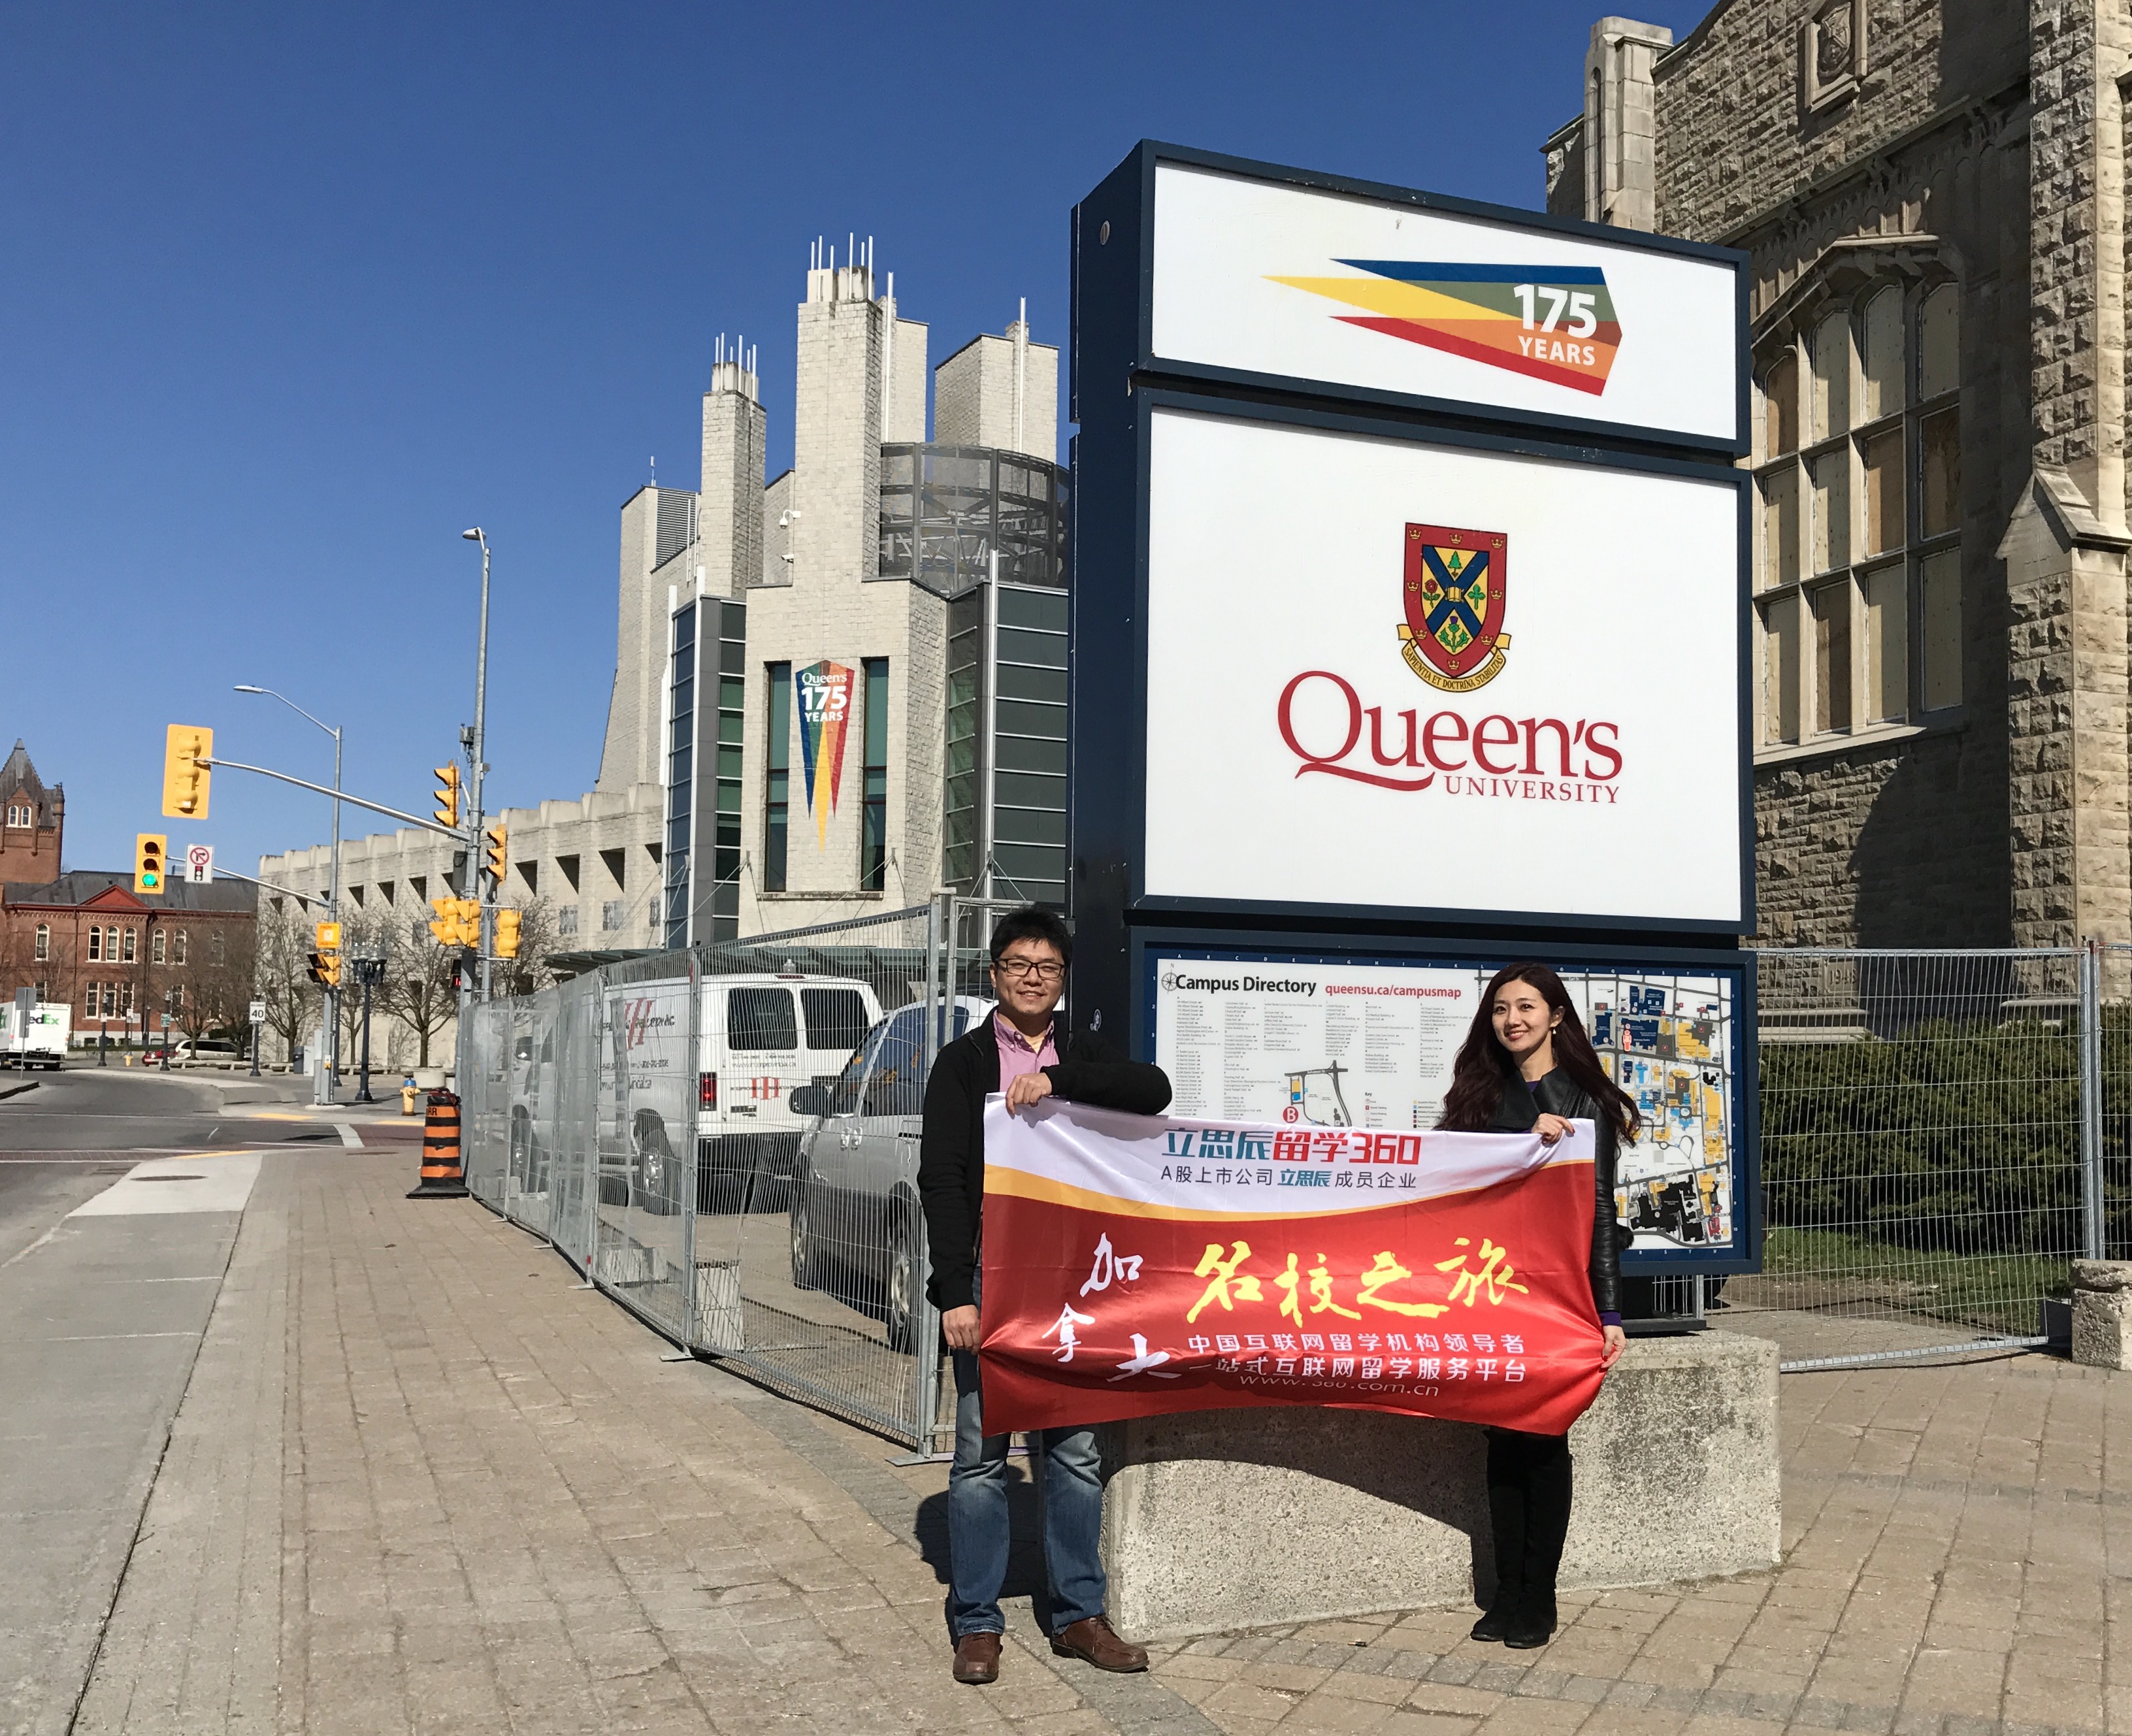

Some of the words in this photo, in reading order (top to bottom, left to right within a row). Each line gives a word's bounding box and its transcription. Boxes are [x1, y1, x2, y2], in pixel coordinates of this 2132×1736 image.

[1514, 284, 1597, 338] 175
[1518, 335, 1595, 366] YEARS
[802, 672, 847, 686] Queen's
[1404, 647, 1432, 681] SAPIENTIA
[1432, 675, 1441, 685] ET
[1442, 679, 1476, 690] DOCTRINA
[1475, 655, 1504, 685] STABILITAS
[802, 685, 847, 710] 175
[804, 712, 844, 723] YEARS
[1278, 670, 1622, 792] Queen's
[1443, 775, 1620, 804] UNIVERSITY
[1175, 974, 1239, 994] Campus
[1243, 976, 1317, 997] Directory
[1325, 984, 1461, 1000] queensu.ca/campusmap
[29, 1013, 59, 1024] edEx
[252, 1009, 264, 1018] 40
[1287, 1108, 1296, 1121] B
[1161, 1128, 1421, 1165] 立思辰留学360
[1160, 1165, 1273, 1187] A股上市公司
[1277, 1168, 1332, 1188] 立思辰
[1335, 1171, 1417, 1188] 成员企业
[1186, 1237, 1529, 1328] 名校之旅
[1187, 1334, 1525, 1354] 中国互联网留学机构领导者
[1189, 1357, 1526, 1383] 一站式互联网留学服务平台
